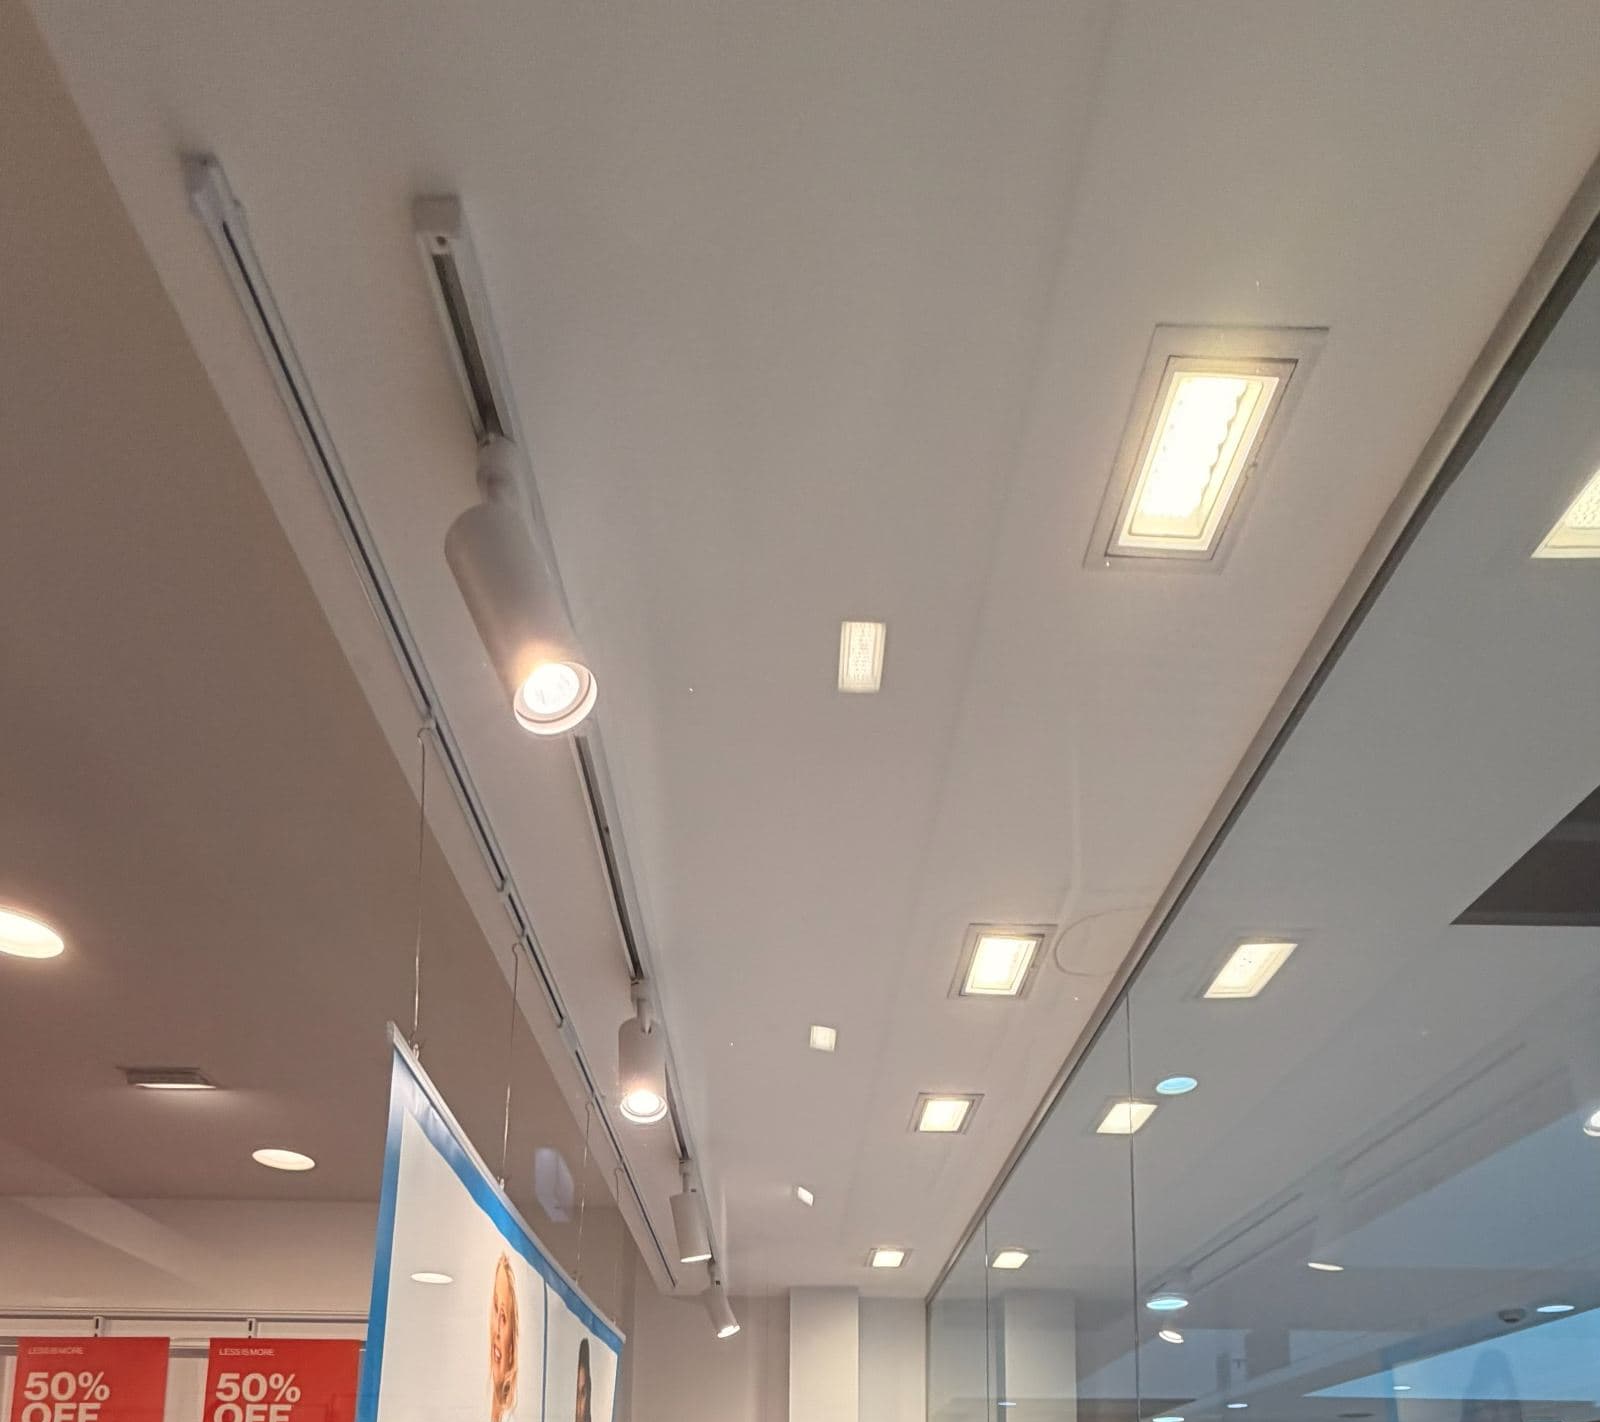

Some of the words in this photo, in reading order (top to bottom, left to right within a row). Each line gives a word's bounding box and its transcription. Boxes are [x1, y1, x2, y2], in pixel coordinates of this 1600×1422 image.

[218, 1348, 240, 1356] LESS
[250, 1348, 275, 1356] MORE
[24, 1371, 110, 1401] 50%
[215, 1373, 301, 1402] 50%
